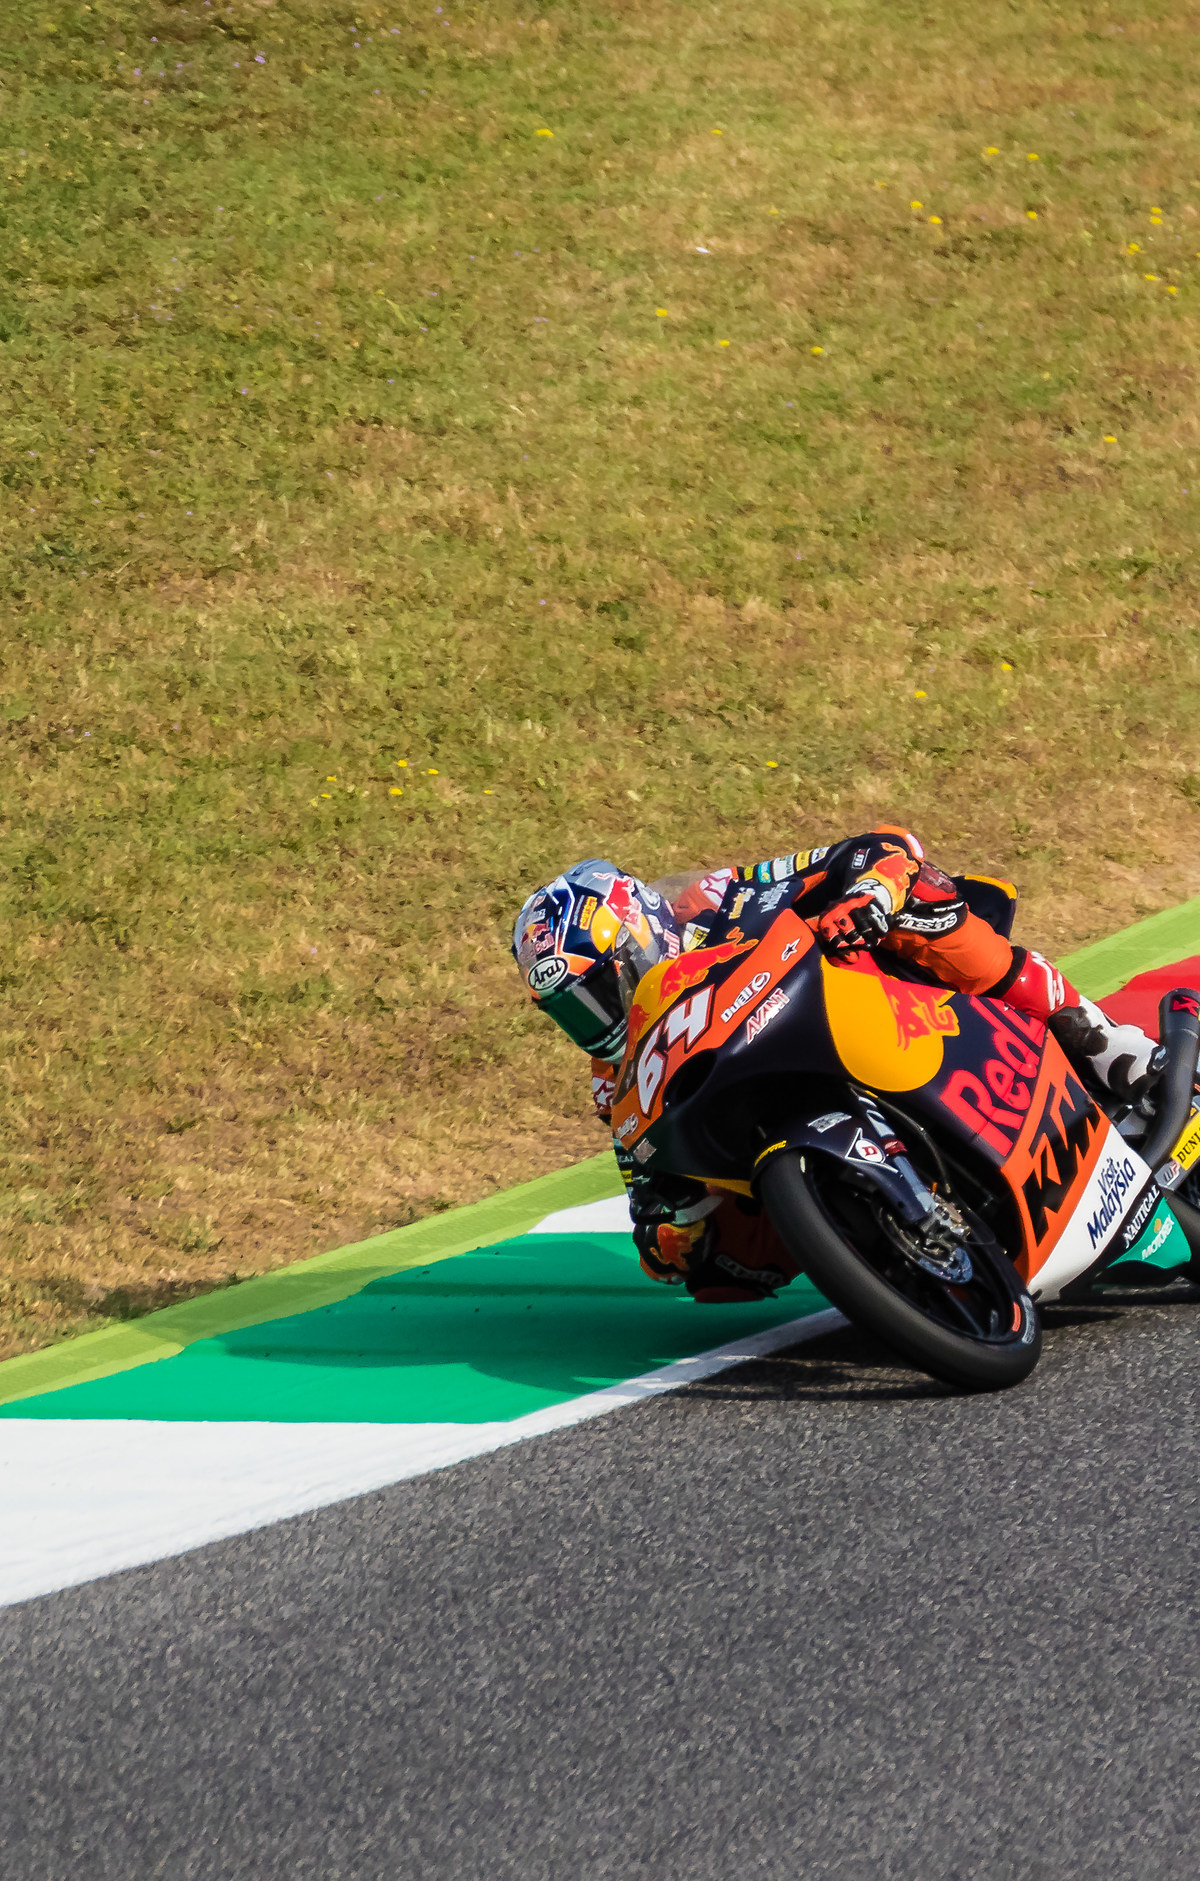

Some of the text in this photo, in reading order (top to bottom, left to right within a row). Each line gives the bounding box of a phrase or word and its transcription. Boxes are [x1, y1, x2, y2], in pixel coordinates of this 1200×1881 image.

[533, 962, 562, 986] Arai
[637, 984, 715, 1119] 64
[746, 988, 790, 1044] AVANT
[940, 994, 1046, 1157] Red
[1020, 1070, 1101, 1247] KTM
[1098, 1157, 1118, 1196] Visit
[1086, 1158, 1136, 1250] Malaysia
[1122, 1184, 1161, 1249] NAUTICAL
